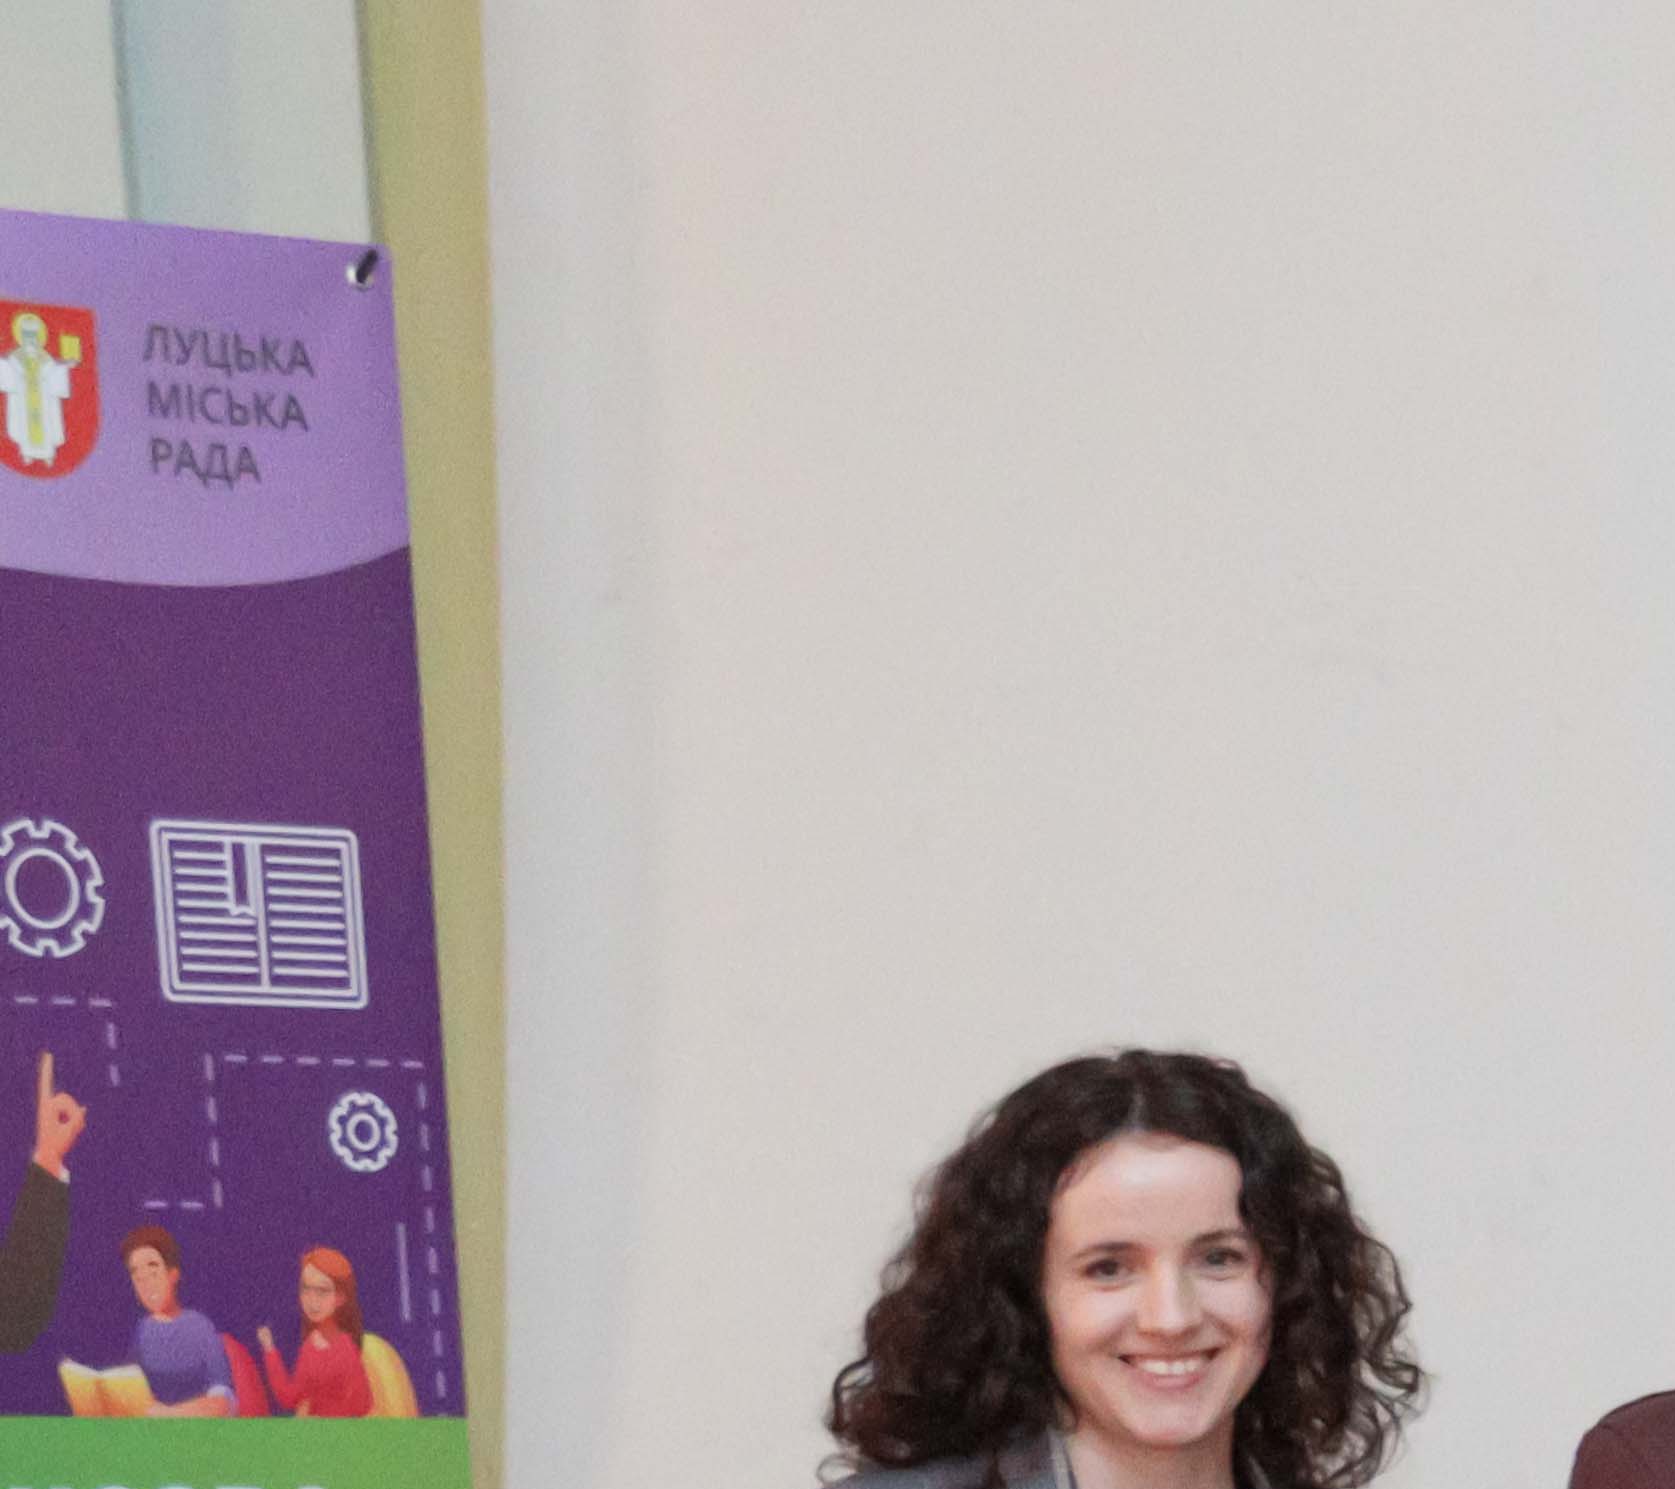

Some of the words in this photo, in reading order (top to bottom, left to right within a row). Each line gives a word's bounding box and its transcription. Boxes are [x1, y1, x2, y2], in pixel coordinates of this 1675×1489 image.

[143, 323, 314, 379] ЛУЦЬКА
[147, 382, 309, 432] МІСЬКА
[150, 437, 261, 490] РАДА
